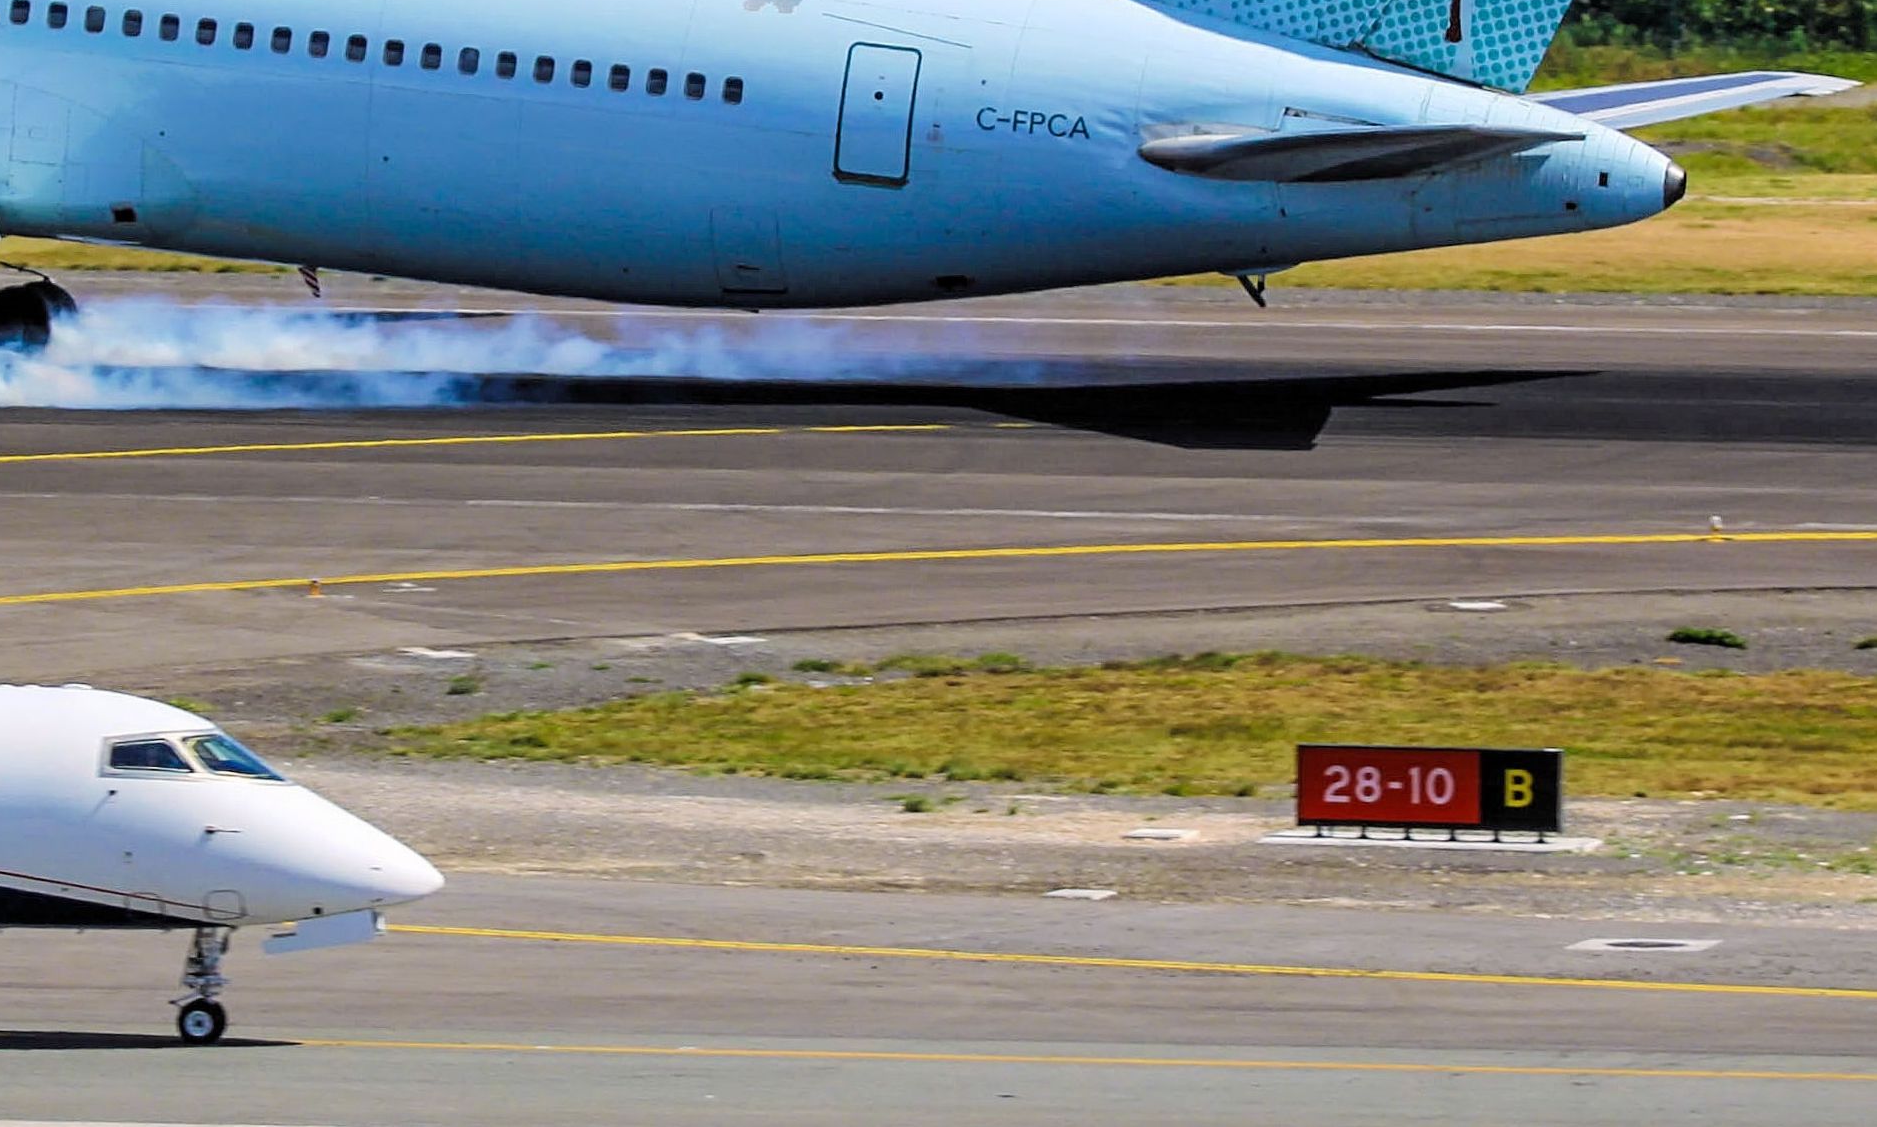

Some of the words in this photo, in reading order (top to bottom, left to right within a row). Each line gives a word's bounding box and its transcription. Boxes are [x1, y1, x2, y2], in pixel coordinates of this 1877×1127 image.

[976, 106, 1091, 140] C-FPCA
[1323, 765, 1455, 805] 28-10
[1503, 768, 1534, 808] B
